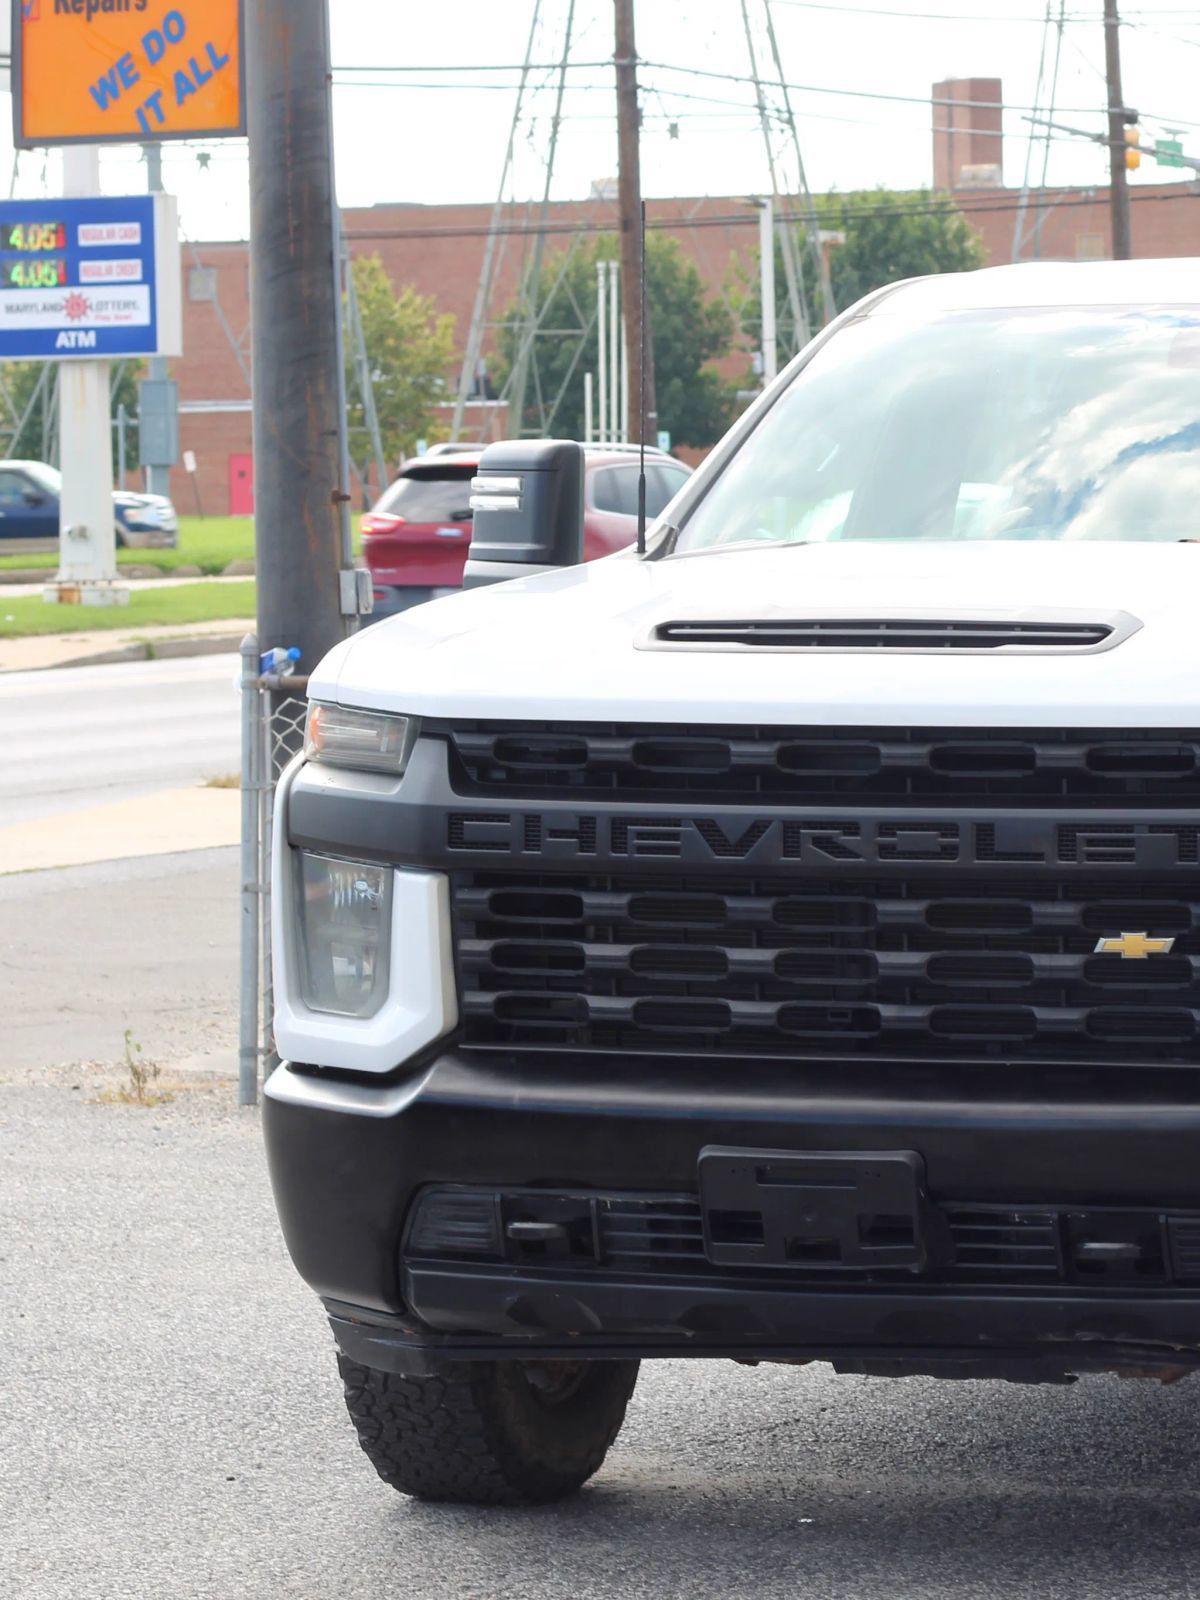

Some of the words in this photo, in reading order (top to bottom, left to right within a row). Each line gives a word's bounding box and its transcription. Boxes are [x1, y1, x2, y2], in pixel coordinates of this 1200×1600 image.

[54, 0, 148, 21] Repairs
[89, 52, 140, 111] WE
[141, 10, 186, 65] DO
[135, 89, 165, 133] IT
[173, 42, 230, 107] ALL
[4, 303, 64, 314] MARYLAND
[55, 329, 97, 349] ATM
